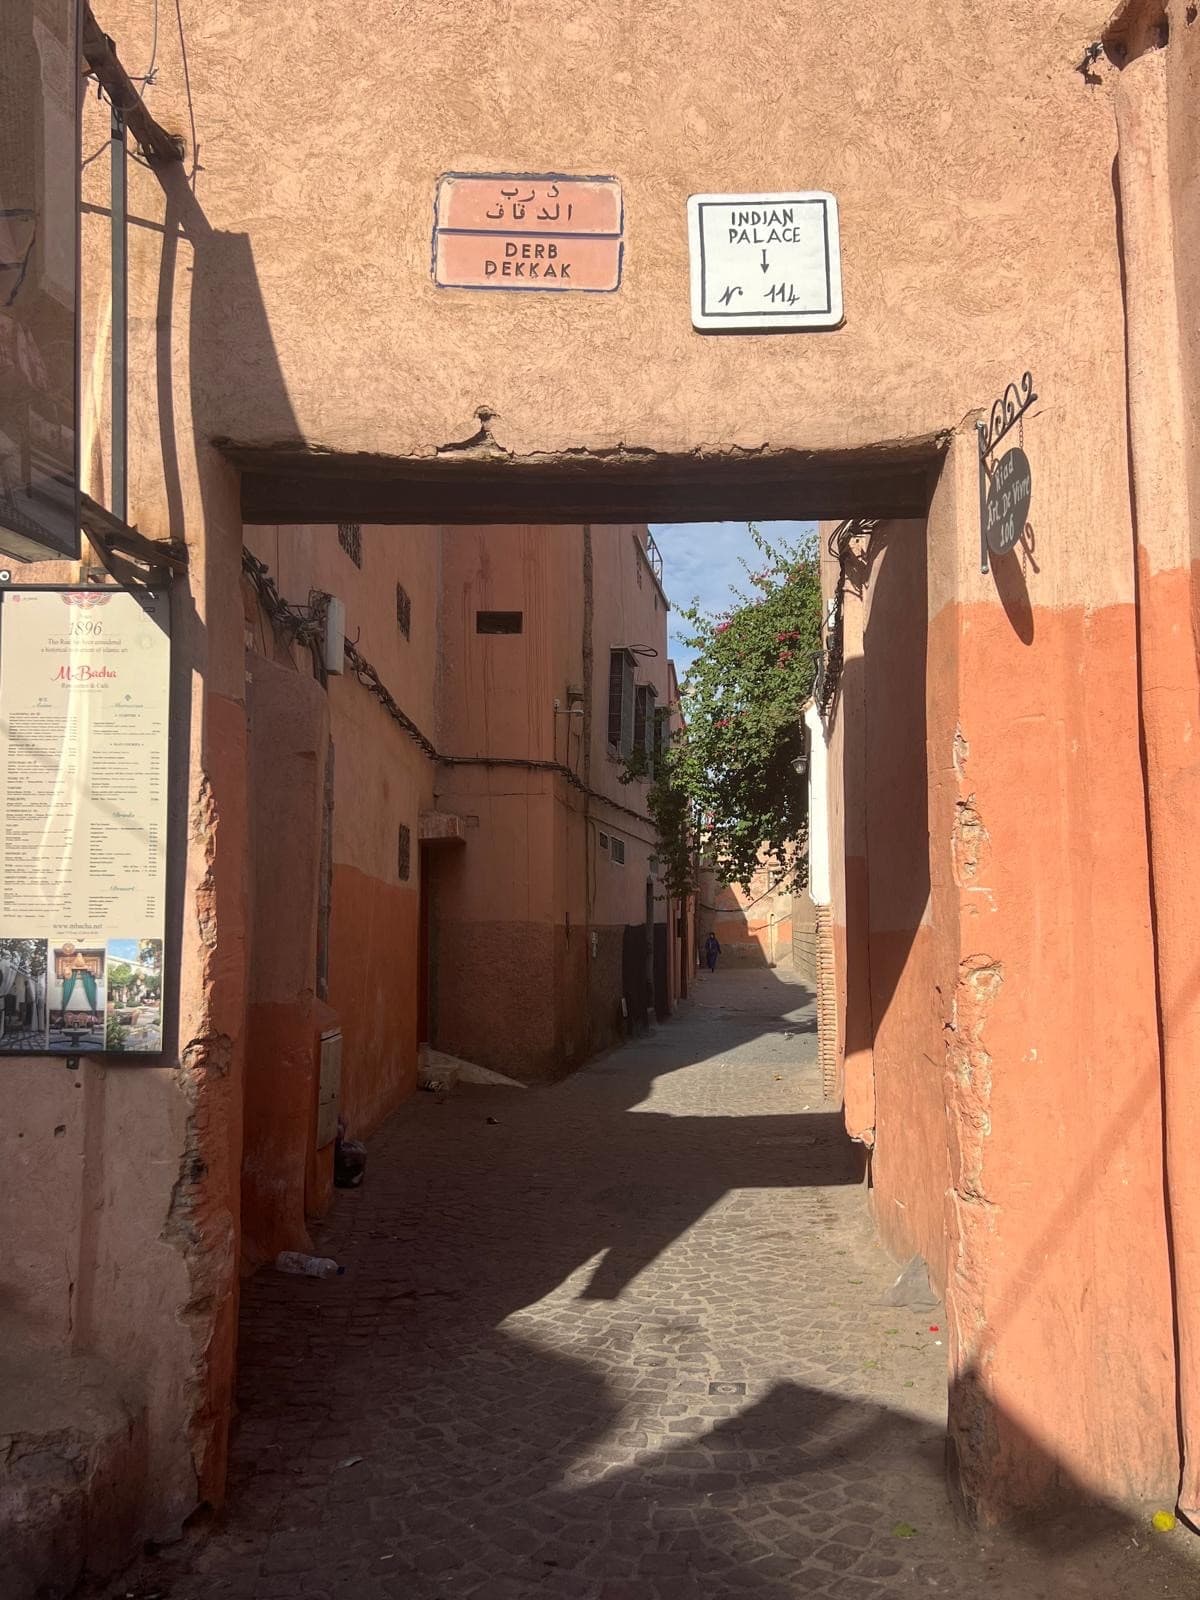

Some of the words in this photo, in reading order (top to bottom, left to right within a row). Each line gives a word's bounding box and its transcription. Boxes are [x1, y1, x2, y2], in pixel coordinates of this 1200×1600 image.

[731, 208, 794, 227] INDIAN
[729, 227, 801, 244] PALACE
[505, 242, 558, 259] DERB
[484, 260, 571, 278] DEKKAK
[764, 282, 800, 305] 114
[68, 620, 103, 636] 1896
